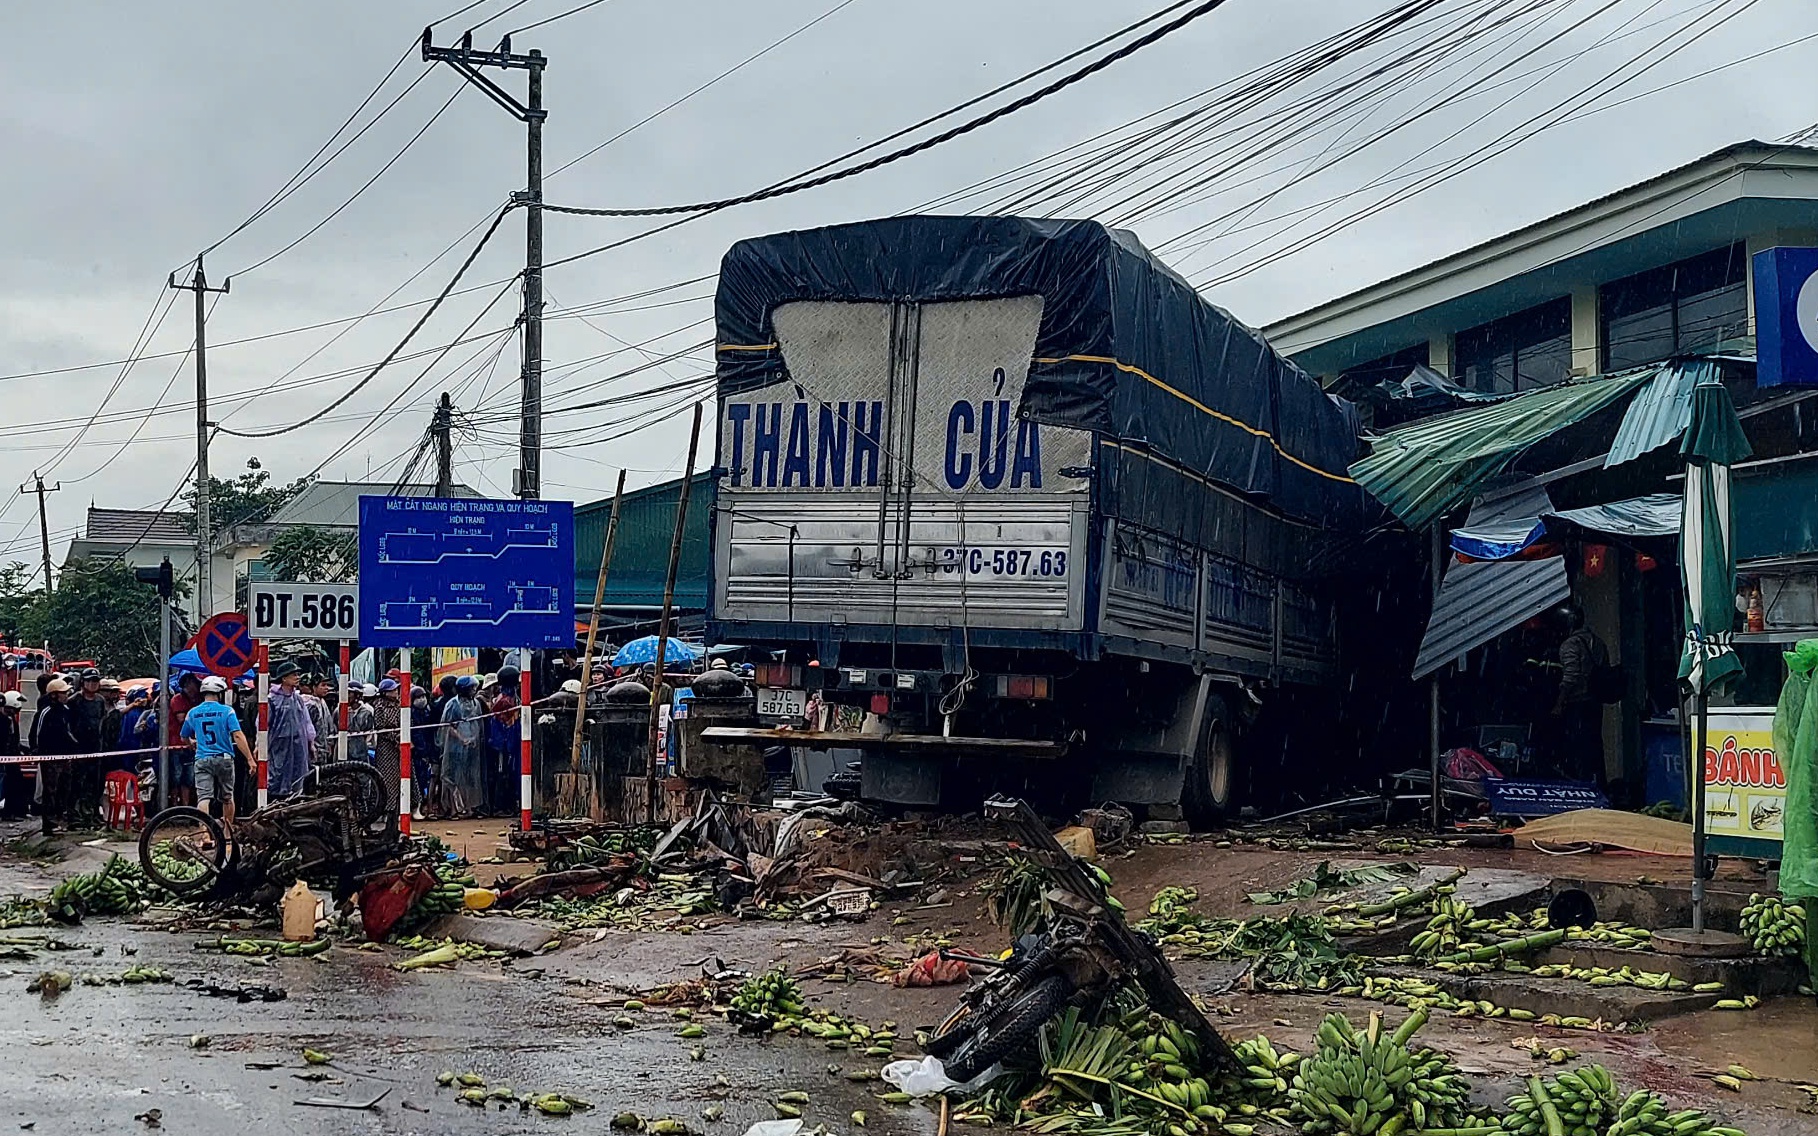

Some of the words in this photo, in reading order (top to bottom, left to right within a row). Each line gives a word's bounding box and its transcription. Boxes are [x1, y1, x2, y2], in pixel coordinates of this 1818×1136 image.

[728, 384, 883, 488] THÀNH
[944, 367, 1042, 490] CỦA
[422, 502, 448, 511] NGANG
[450, 501, 468, 512] HIỆN
[469, 503, 494, 513] TRẠNG
[496, 502, 505, 513] VÀ
[507, 503, 521, 513] QUY
[524, 504, 548, 515] HOẠCH
[465, 516, 485, 525] TRẠNG
[944, 549, 1067, 577] 37C-587.63
[255, 593, 355, 630] ĐT.586
[771, 691, 792, 701] 37C
[762, 702, 800, 714] 587.63
[202, 721, 217, 745] 5
[1704, 737, 1787, 787] BÁNH
[1497, 787, 1538, 796] DUY
